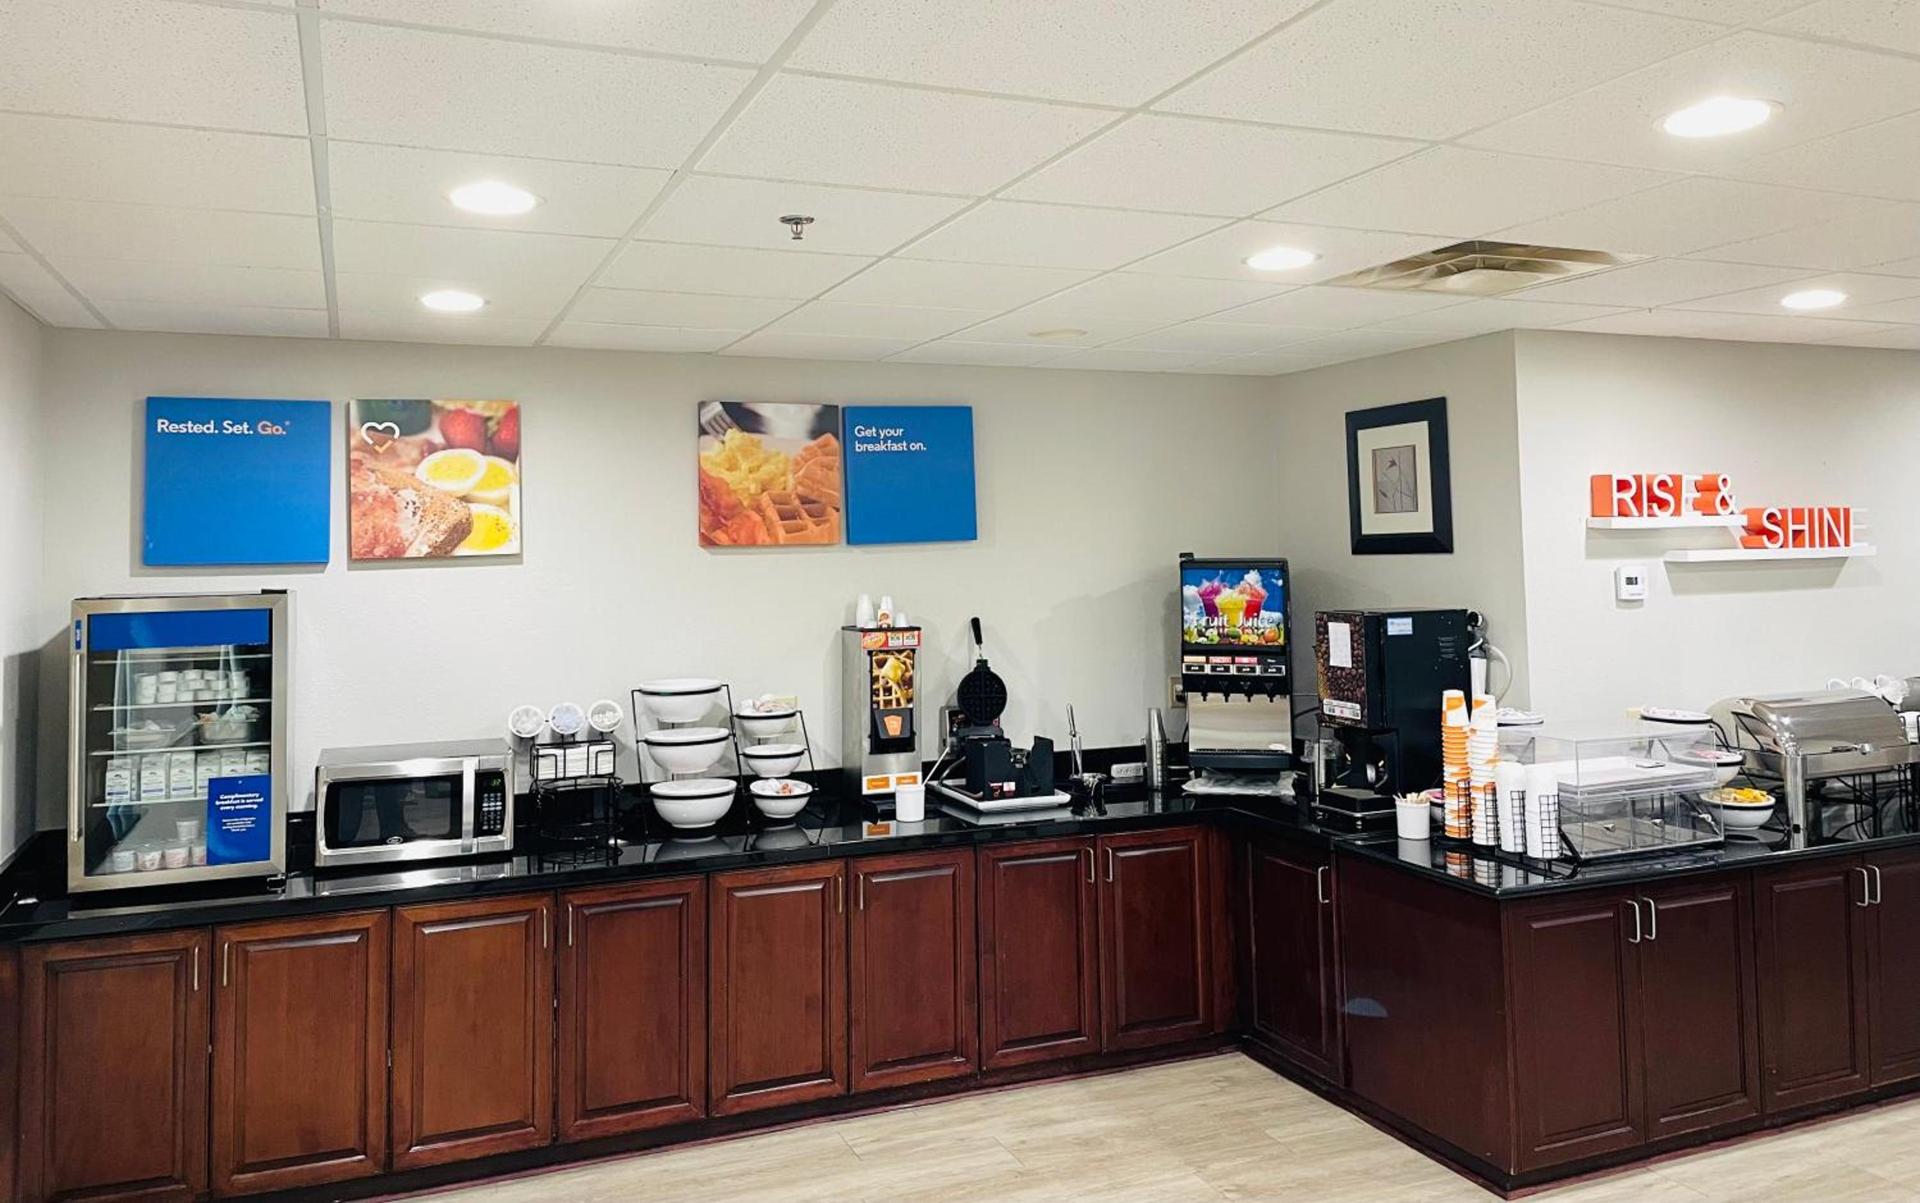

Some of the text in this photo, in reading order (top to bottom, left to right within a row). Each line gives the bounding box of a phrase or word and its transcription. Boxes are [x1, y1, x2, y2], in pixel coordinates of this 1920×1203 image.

[157, 419, 218, 434] Rested.
[222, 420, 253, 435] Set.
[854, 425, 904, 439] Get your
[855, 440, 927, 452] breakfast on.
[1611, 473, 1738, 517] RISE &
[1762, 506, 1868, 549] SHINE
